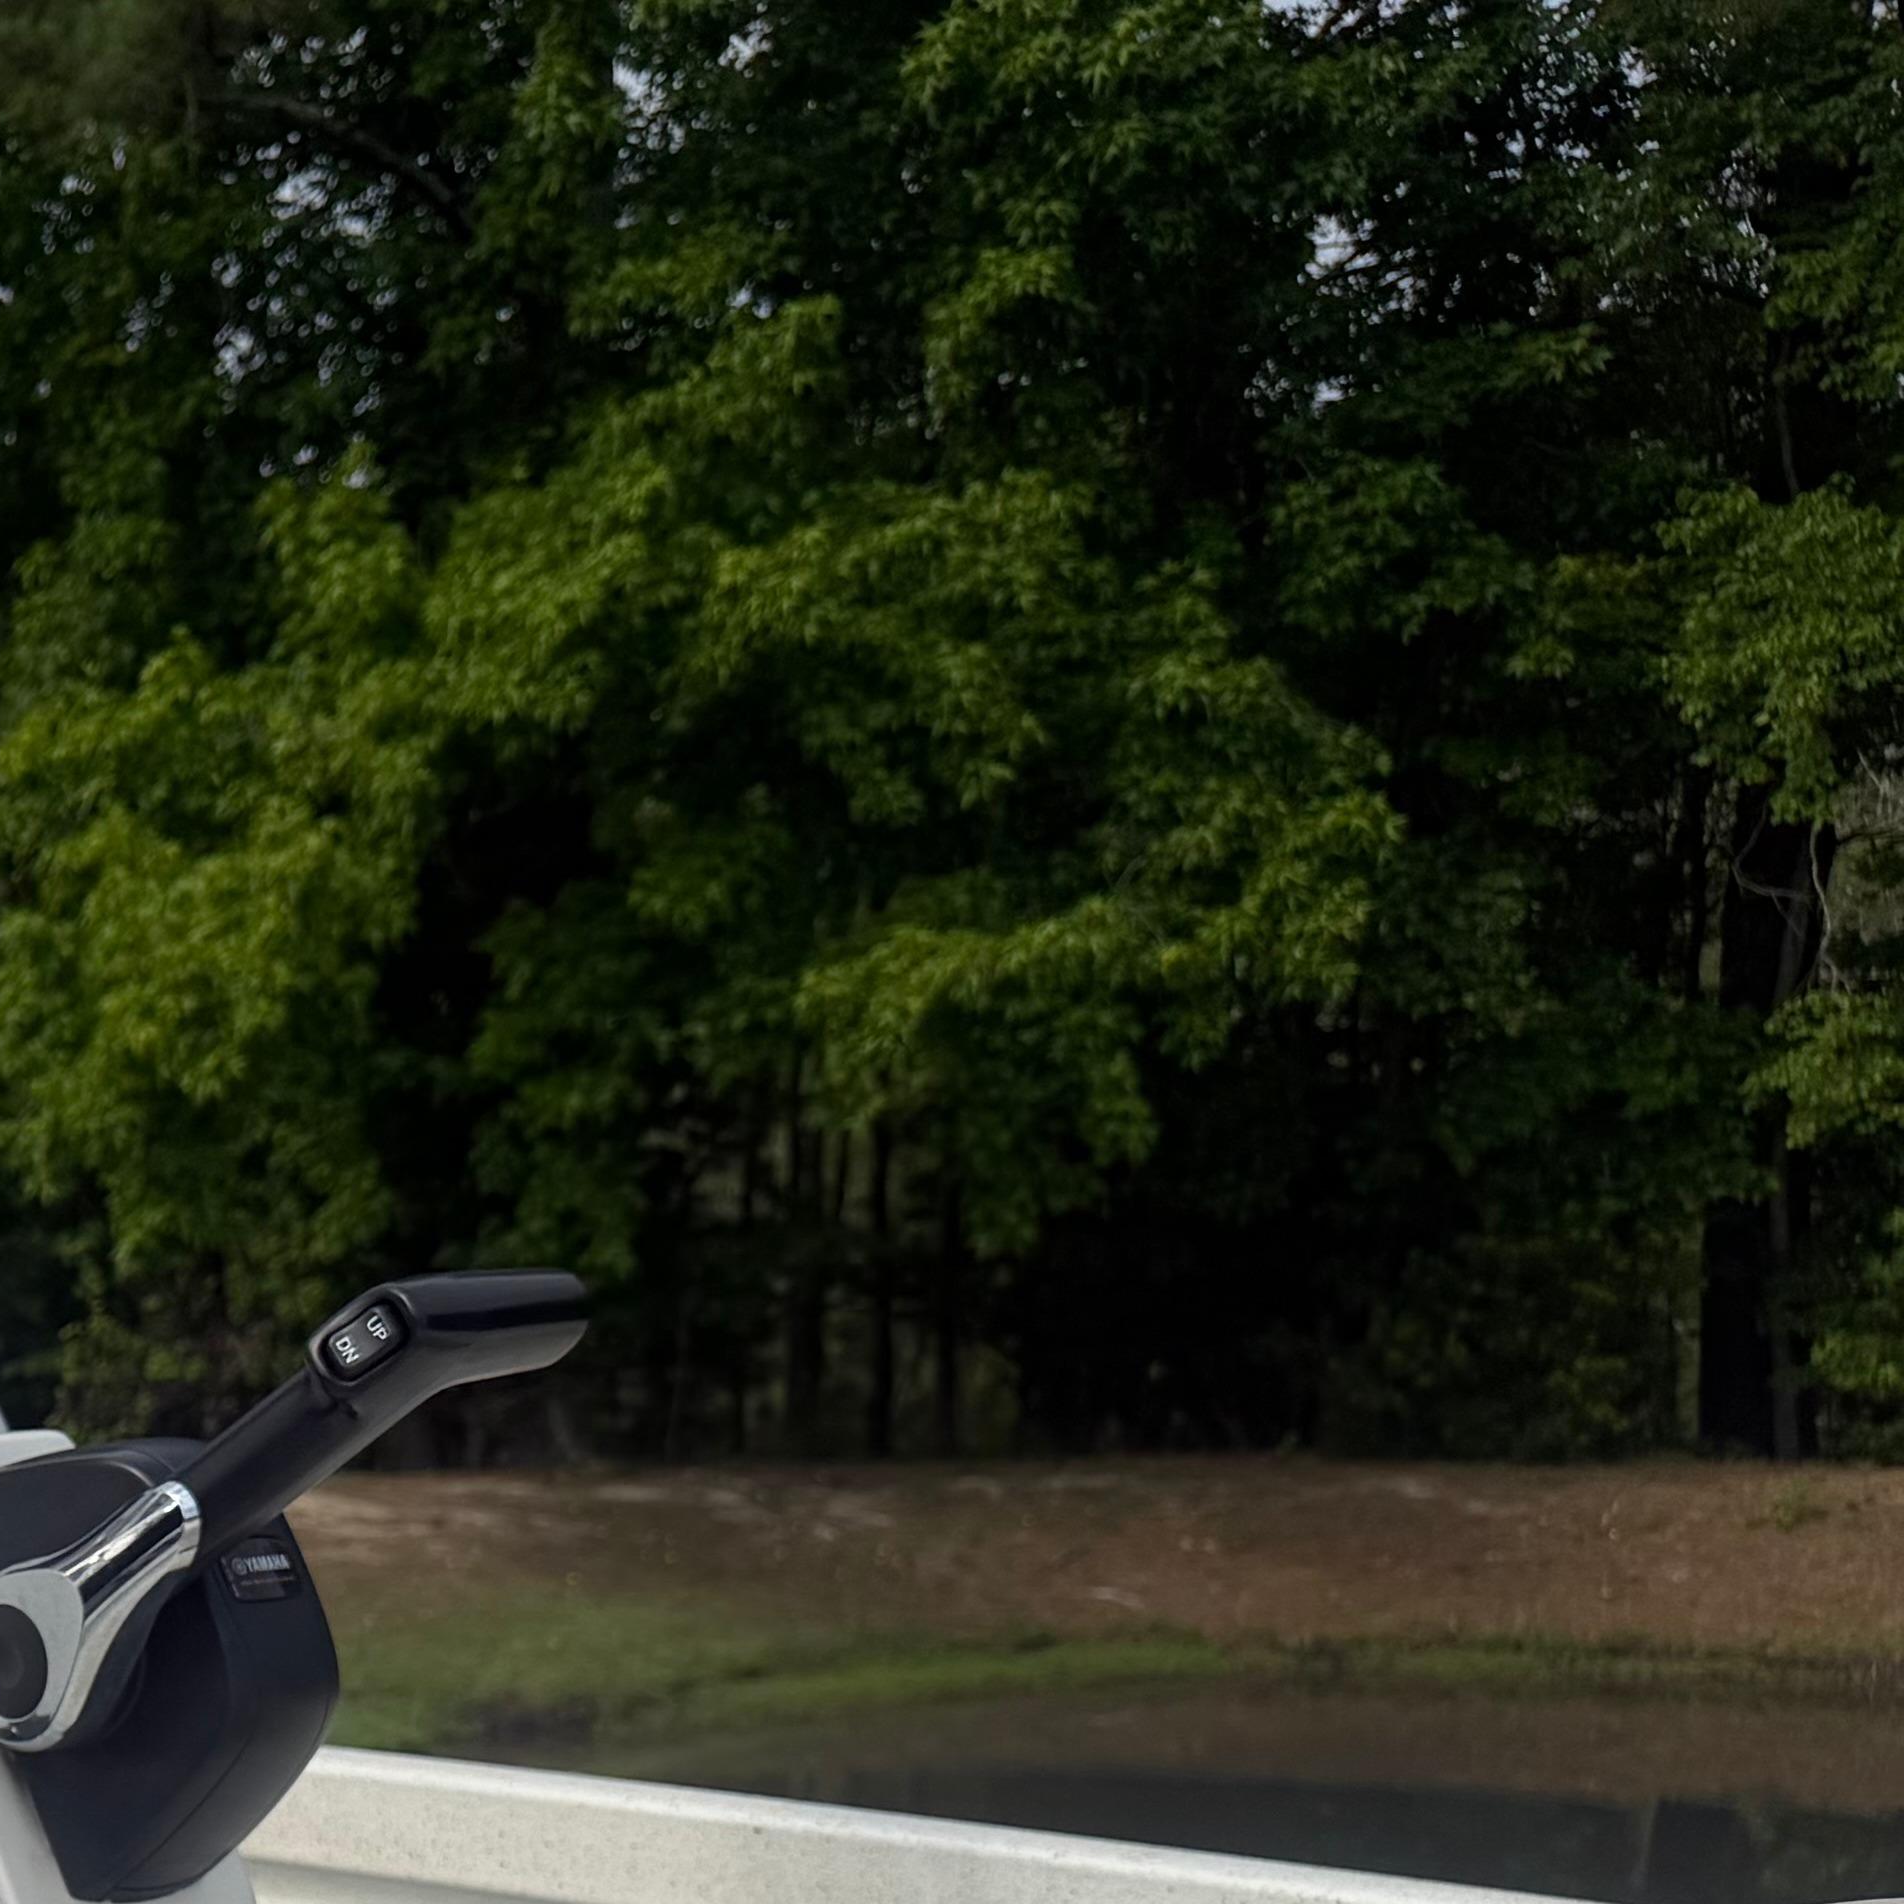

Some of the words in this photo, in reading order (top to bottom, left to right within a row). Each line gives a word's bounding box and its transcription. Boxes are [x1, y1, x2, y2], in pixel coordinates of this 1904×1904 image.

[366, 1315, 388, 1340] UP
[335, 1336, 360, 1364] DN
[243, 1554, 290, 1572] YAMAHA
